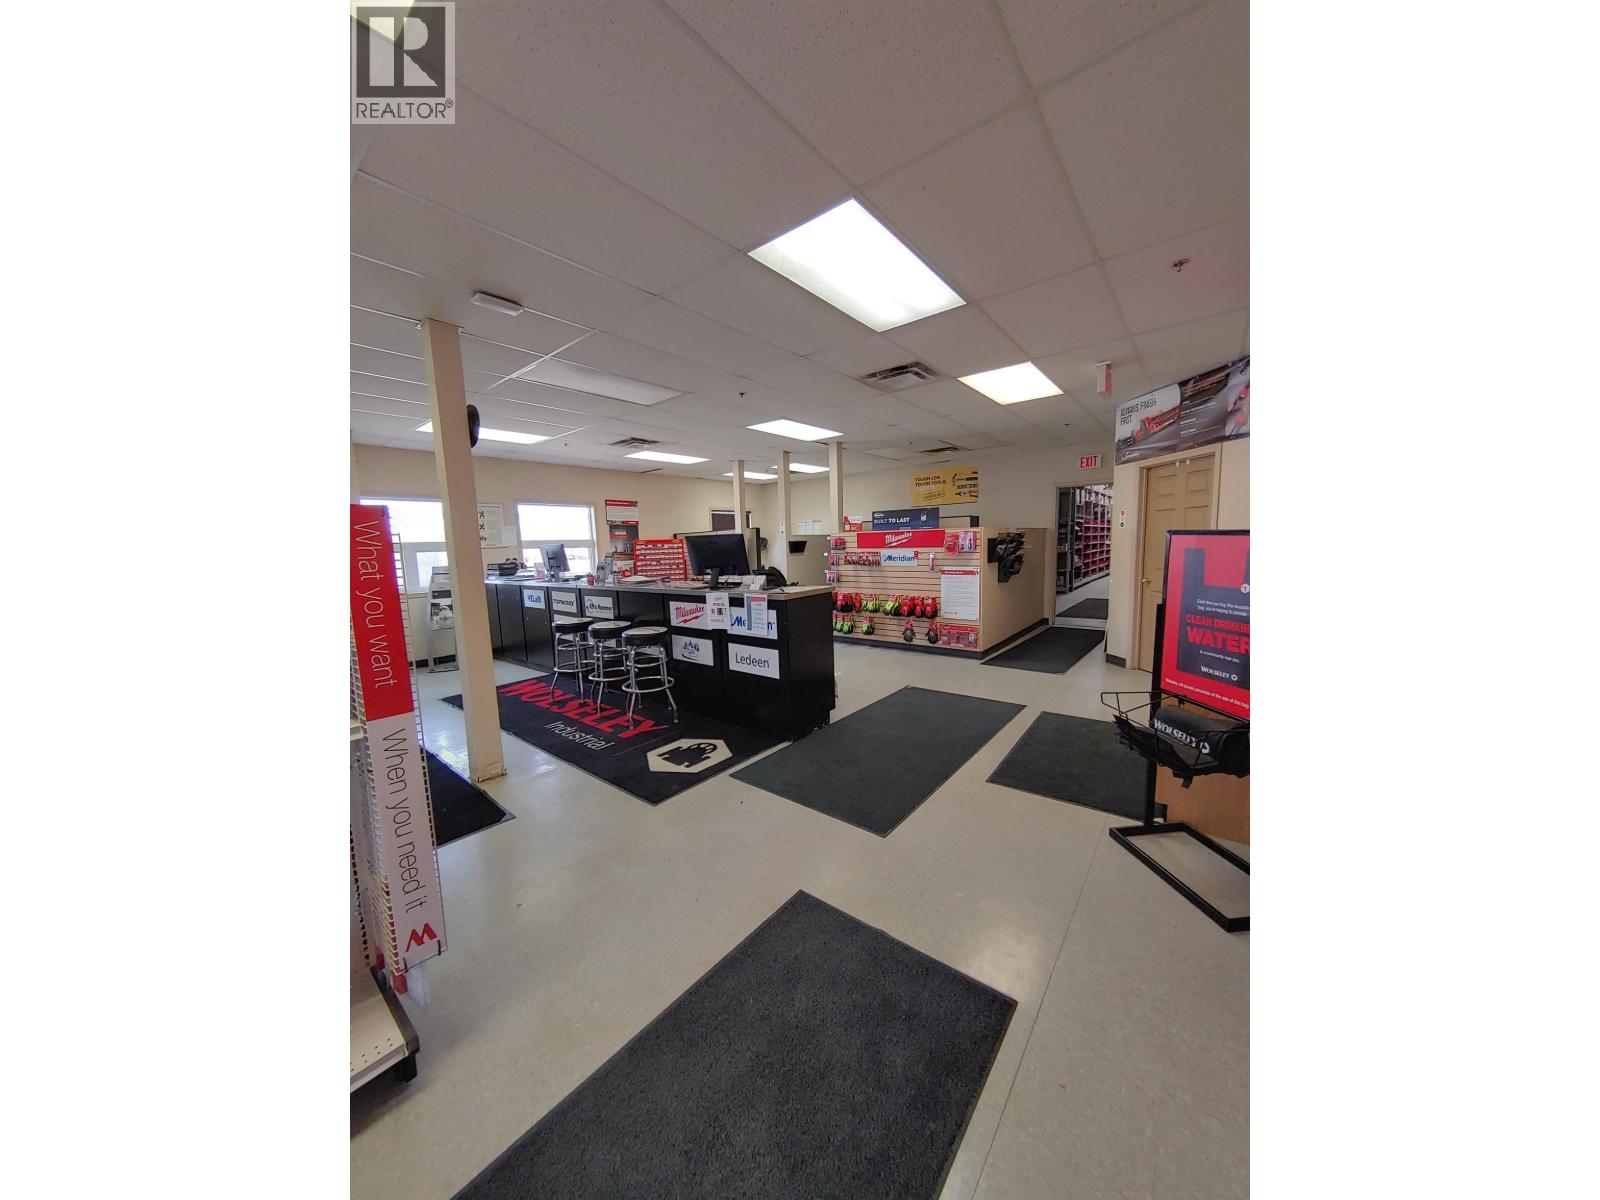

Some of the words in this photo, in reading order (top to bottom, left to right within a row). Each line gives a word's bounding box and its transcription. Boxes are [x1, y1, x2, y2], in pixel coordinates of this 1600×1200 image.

[1120, 402, 1139, 418] ALWAYS
[1140, 396, 1157, 412] FINISH
[1120, 415, 1133, 427] FIRST
[1080, 456, 1098, 469] EXIT
[884, 532, 913, 545] Milwaukee
[353, 520, 381, 580] What
[883, 554, 915, 562] Meridian
[356, 585, 385, 628] you
[676, 604, 705, 620] Milwaukee
[1186, 614, 1212, 627] CLEAN
[683, 640, 700, 652] JAG
[1187, 626, 1249, 655] WATER
[369, 634, 396, 688] want
[736, 652, 771, 669] Ledeen
[1201, 665, 1230, 679] WOLSELEY
[498, 680, 670, 740] WOLSELEY
[544, 720, 615, 755] Industrial
[382, 728, 408, 794] When
[386, 796, 412, 840] you
[397, 842, 426, 895] need
[405, 898, 425, 913] it
